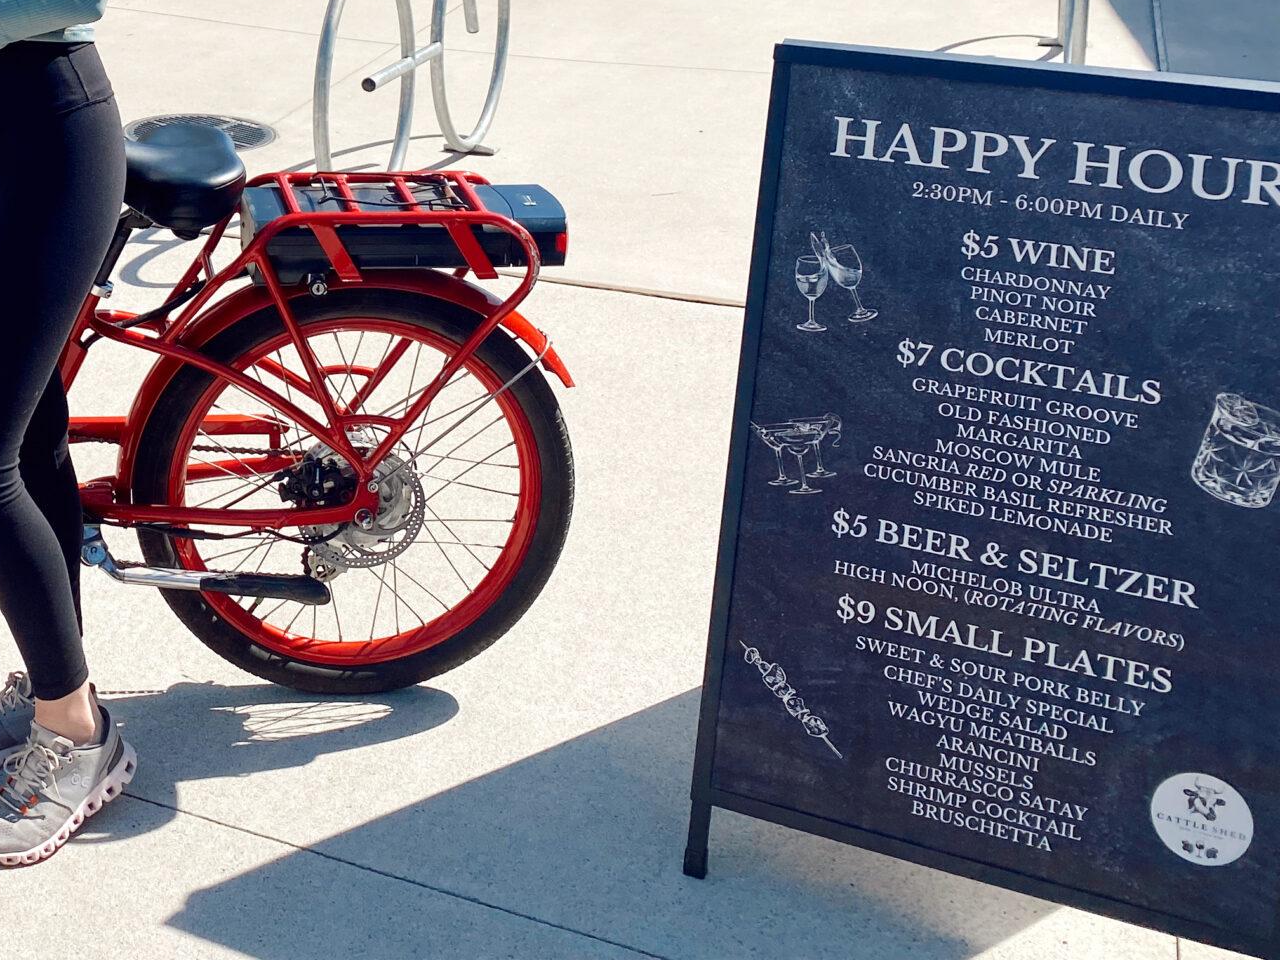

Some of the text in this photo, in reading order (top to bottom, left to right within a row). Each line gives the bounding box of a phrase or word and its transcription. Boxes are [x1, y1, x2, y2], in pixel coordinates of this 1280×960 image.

[829, 115, 1280, 207] HAPPY HOUR
[911, 181, 994, 207] 2:30PM
[1014, 193, 1104, 220] 6:00PM
[1109, 204, 1190, 230] DAILY
[960, 229, 1116, 275] $5 WINE
[960, 266, 1112, 300] CHARDONNAY
[969, 285, 1097, 318] PINOT NOIR
[975, 305, 1089, 335] CABERNET
[983, 327, 1076, 355] MERLOT
[896, 337, 1162, 405] $7 COCKTAILS
[911, 377, 1139, 429] GRAPEFRUIT GROOVE
[937, 402, 1111, 445] OLD FASHIONED
[934, 438, 1101, 483] MOSCOW MULE
[955, 423, 1083, 460] MARGARITA
[863, 463, 1174, 536] CUCUMBER BASIL REFRESHER
[872, 445, 1168, 513] SANGRIA RED OR SPARKLING
[913, 490, 1113, 543] SPIKED LEMONADE
[831, 507, 1200, 610] $5 BEER & SELTZER
[833, 559, 1185, 652] HIGH NOON, (ROTATING FLAVORS)
[910, 559, 1101, 614] MICHELOB ULTRA
[836, 592, 1173, 694] $9 SMALL PLATES
[855, 635, 1146, 717] SWEET & SOUR PORK BELLY
[883, 664, 1114, 734] CHEF'S DAILY SPECIAL
[887, 700, 1097, 767] WAGYU MEATBALLS
[916, 690, 1068, 741] WEDGE SALAD
[935, 734, 1040, 773] ARANCINI
[938, 752, 1034, 790] MUSSELS
[885, 756, 1089, 822] CHURRASCO SATAY
[887, 776, 1082, 842] SHRIMP COCKTAIL
[910, 799, 1053, 852] BRUSCHETTA
[1157, 812, 1208, 831] CATTLE
[1212, 826, 1247, 841] SHED
